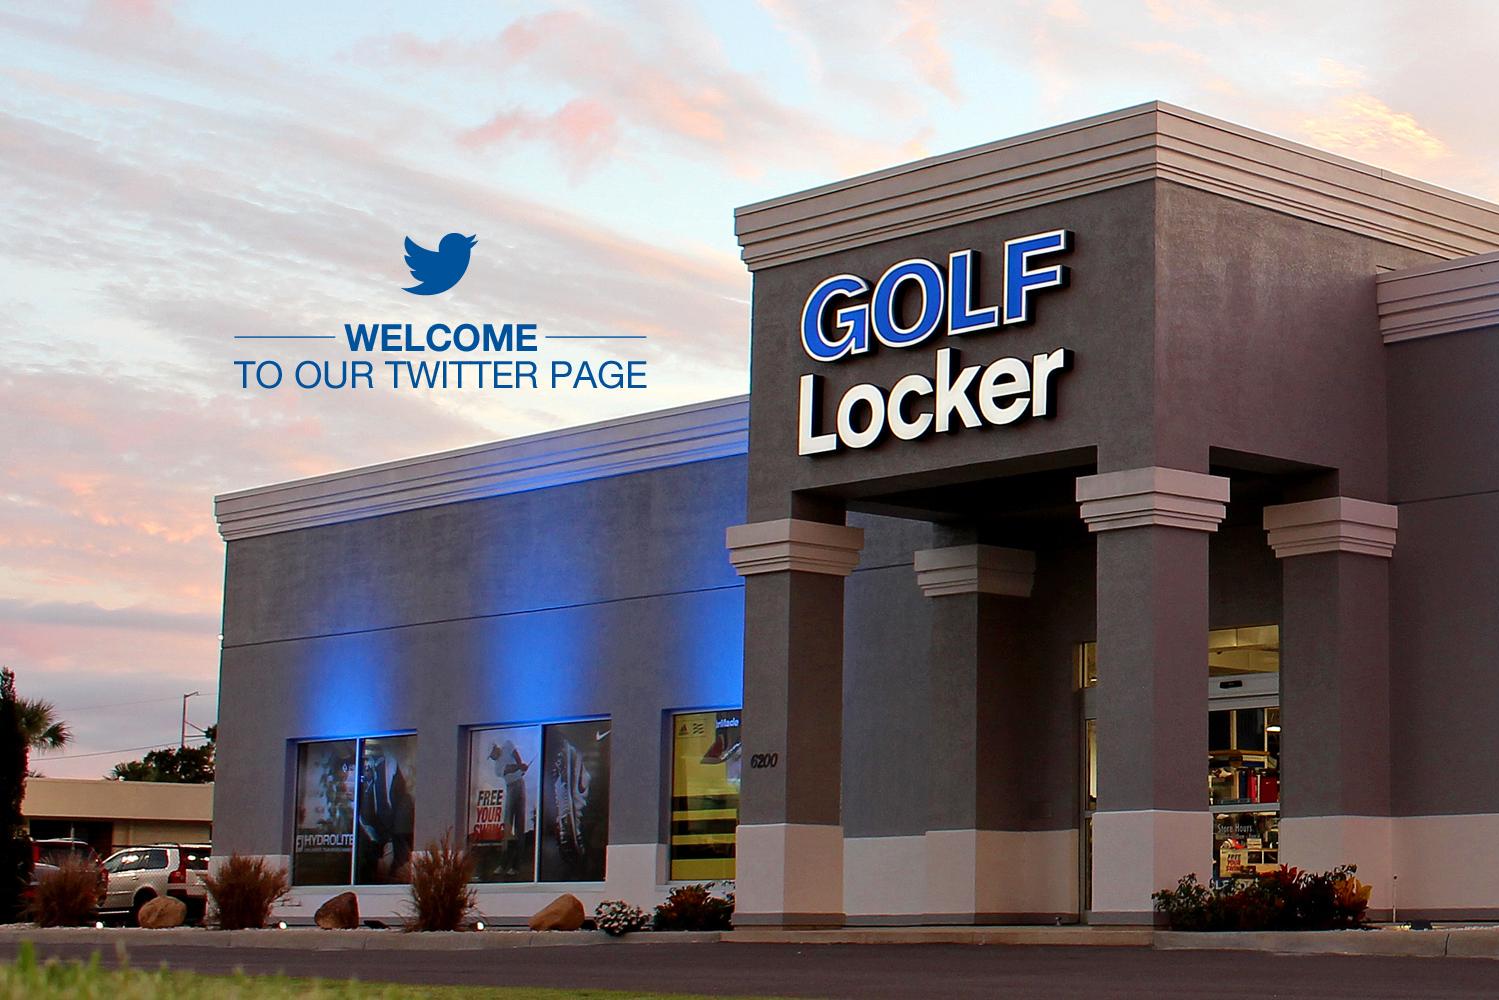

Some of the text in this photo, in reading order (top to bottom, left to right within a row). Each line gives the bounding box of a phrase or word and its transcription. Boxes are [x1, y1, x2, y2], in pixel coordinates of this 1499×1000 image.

[801, 229, 1067, 362] GOLF
[799, 347, 1065, 456] Locker
[476, 806, 503, 823] YOUR
[477, 789, 504, 806] FREE
